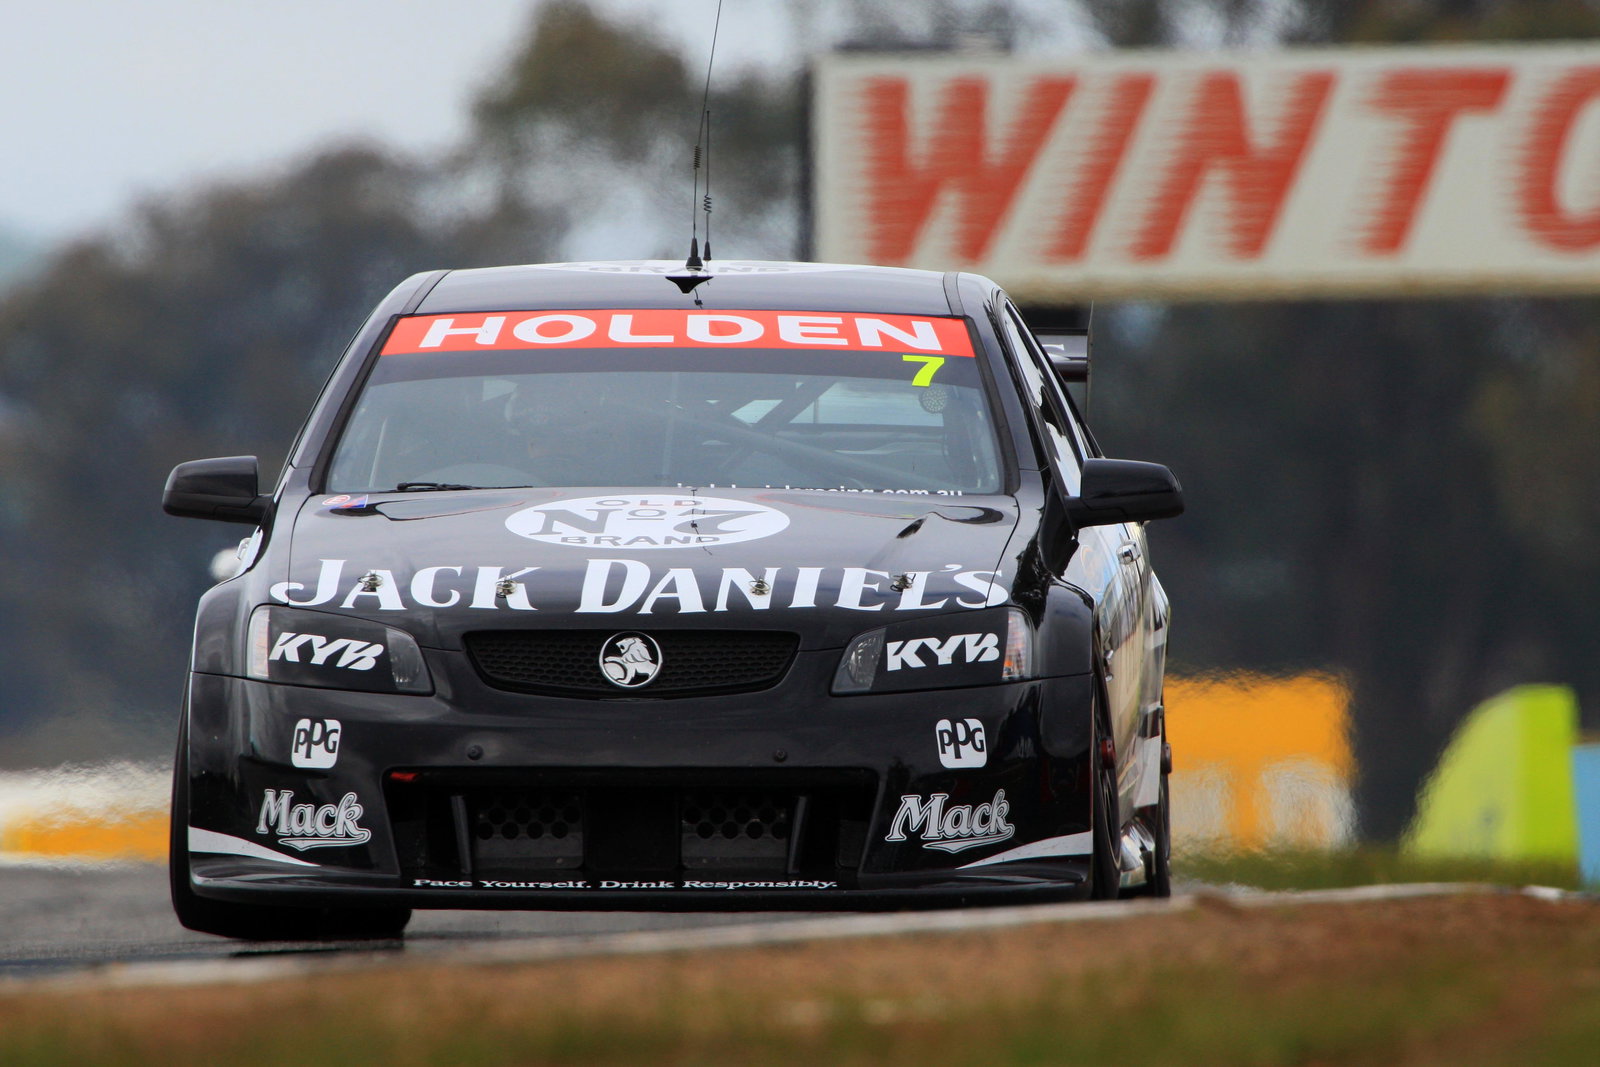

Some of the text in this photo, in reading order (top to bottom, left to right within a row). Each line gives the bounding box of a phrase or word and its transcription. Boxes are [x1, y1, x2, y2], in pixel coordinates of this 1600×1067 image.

[419, 314, 942, 351] HOLDEN
[902, 355, 945, 387] 7
[595, 499, 703, 507] OLD
[560, 535, 721, 547] BRAND
[269, 558, 1009, 615] JACK DANIEL'S
[268, 631, 385, 672] KYB
[886, 632, 1000, 672] KYB
[256, 789, 372, 851] Mack
[884, 788, 1015, 853] Mack
[413, 878, 838, 890] Pace Yourself. Drink Responsibly.
